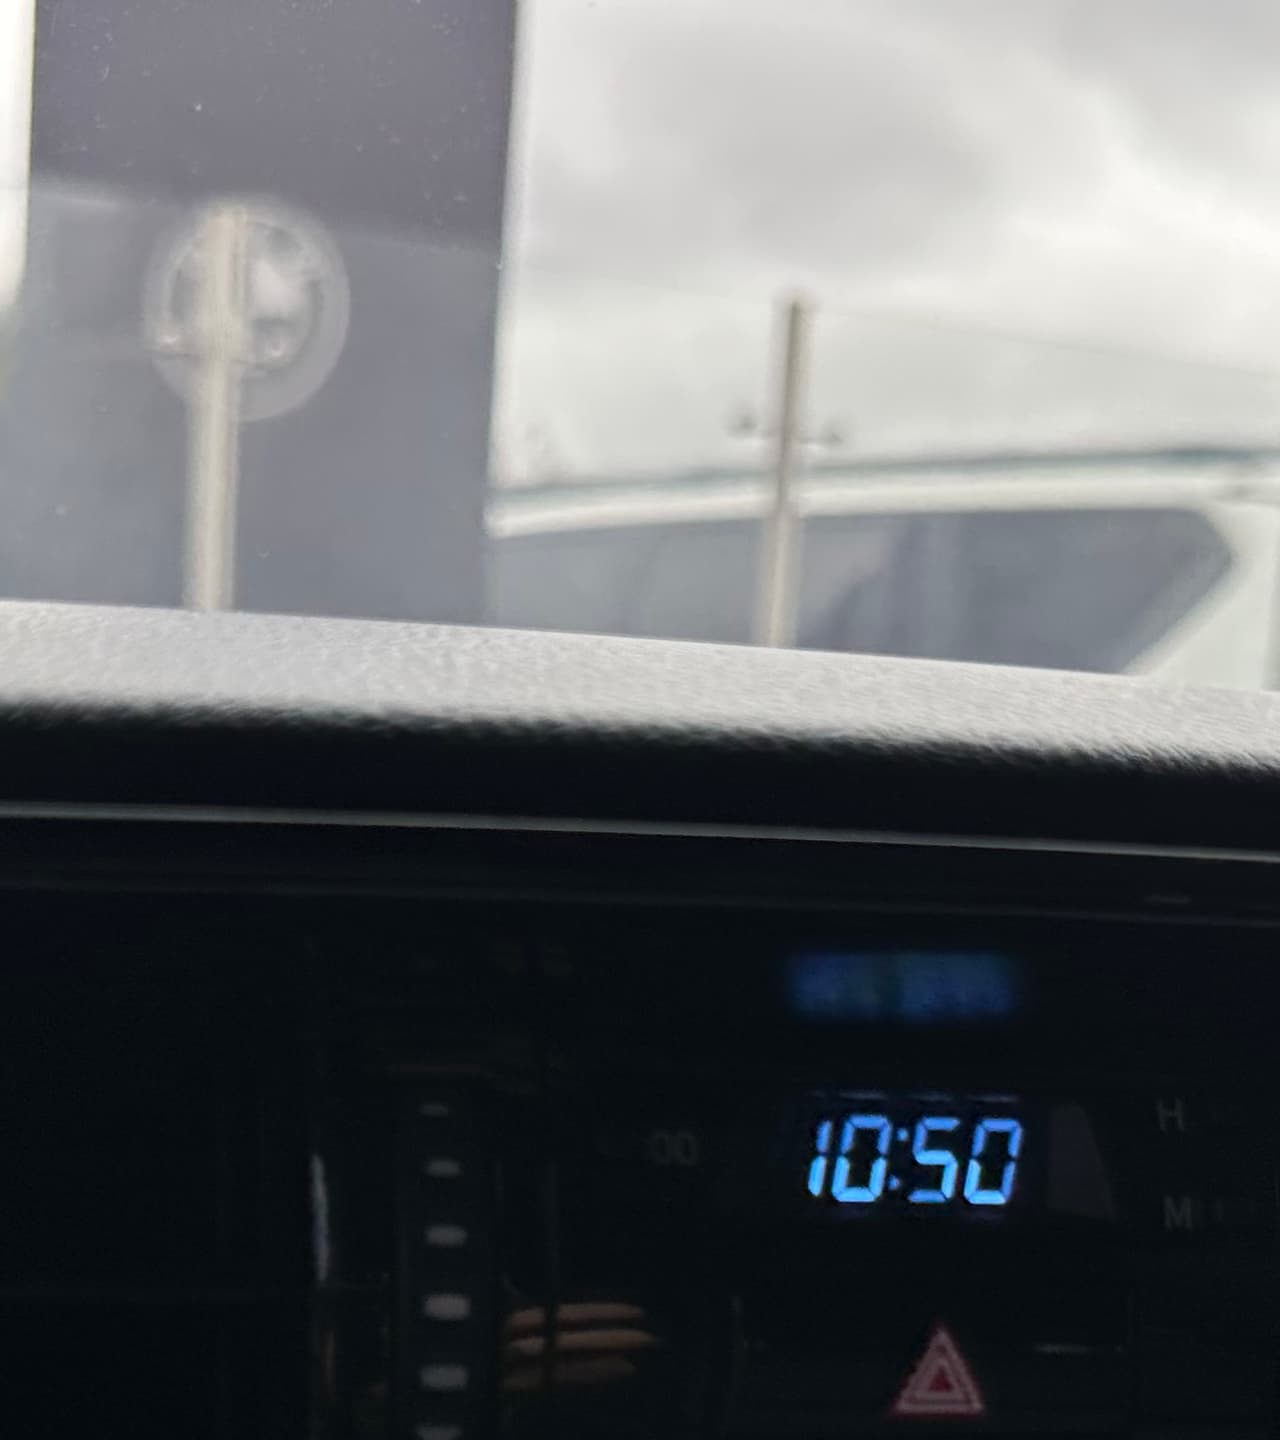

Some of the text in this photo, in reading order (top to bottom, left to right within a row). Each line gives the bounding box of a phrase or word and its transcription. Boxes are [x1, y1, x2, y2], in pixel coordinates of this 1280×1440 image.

[1157, 1099, 1186, 1132] H
[807, 1112, 1024, 1205] 10:50
[1164, 1198, 1194, 1230] M
